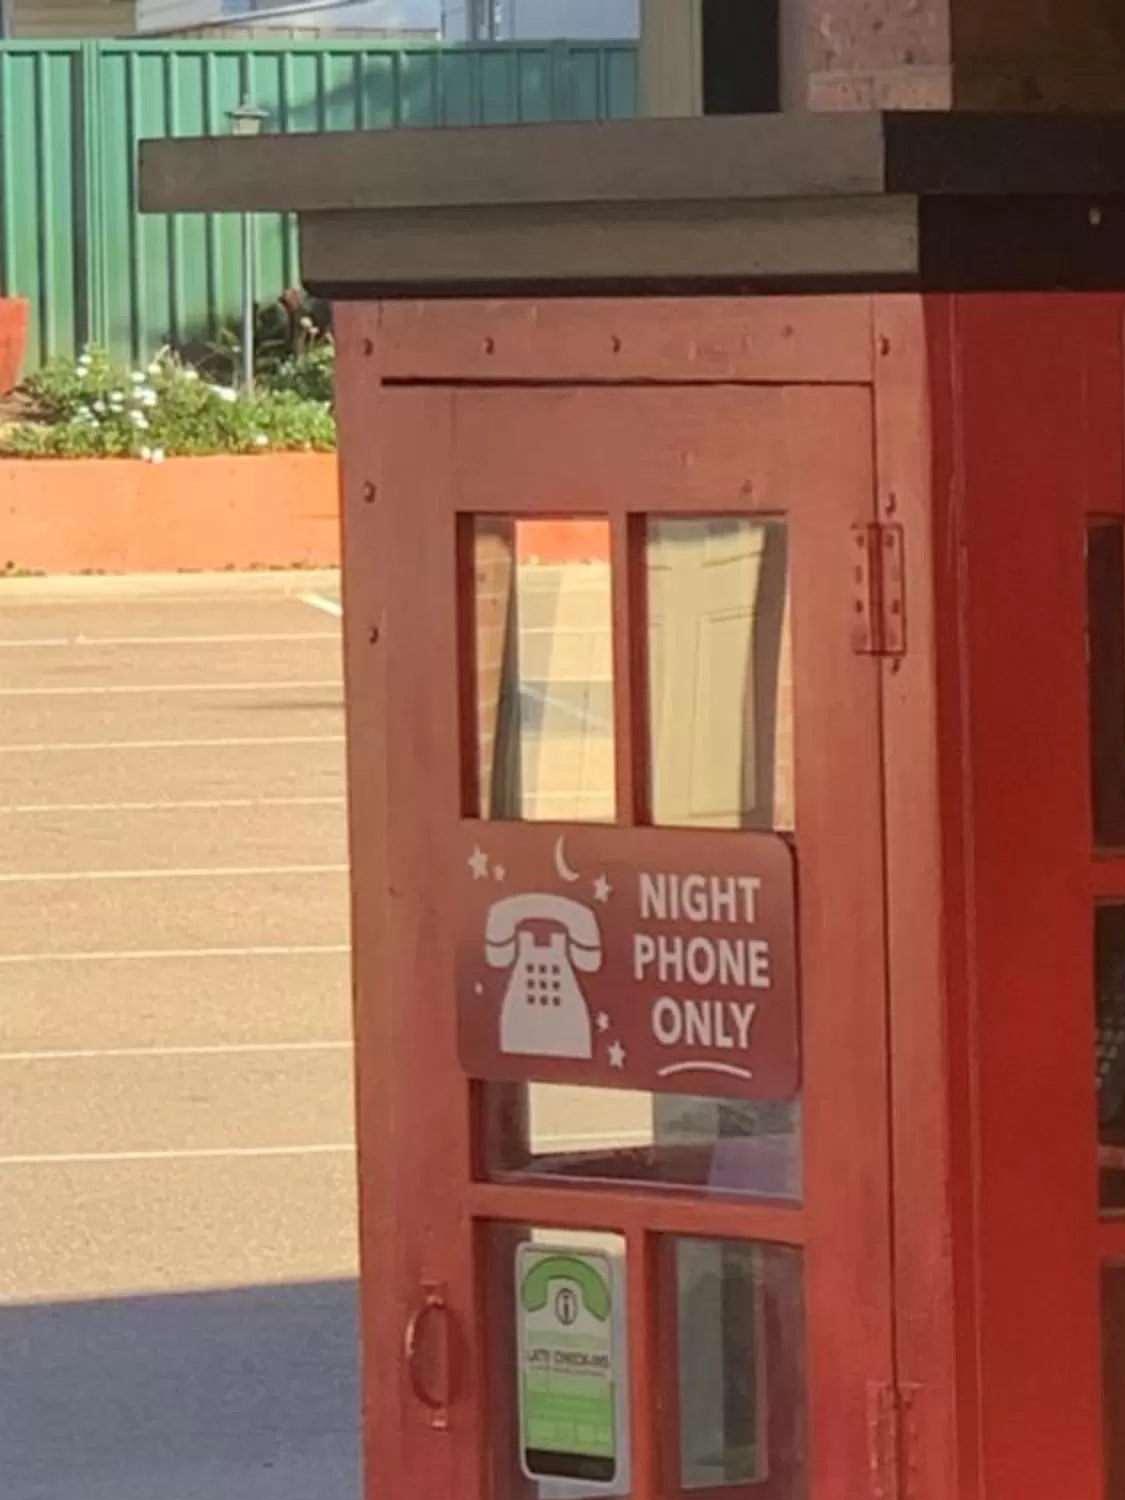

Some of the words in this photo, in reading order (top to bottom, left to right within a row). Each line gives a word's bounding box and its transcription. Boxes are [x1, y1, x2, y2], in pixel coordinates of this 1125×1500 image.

[640, 873, 761, 923] NIGHT
[633, 934, 770, 988] PHONE
[652, 997, 755, 1049] ONLY
